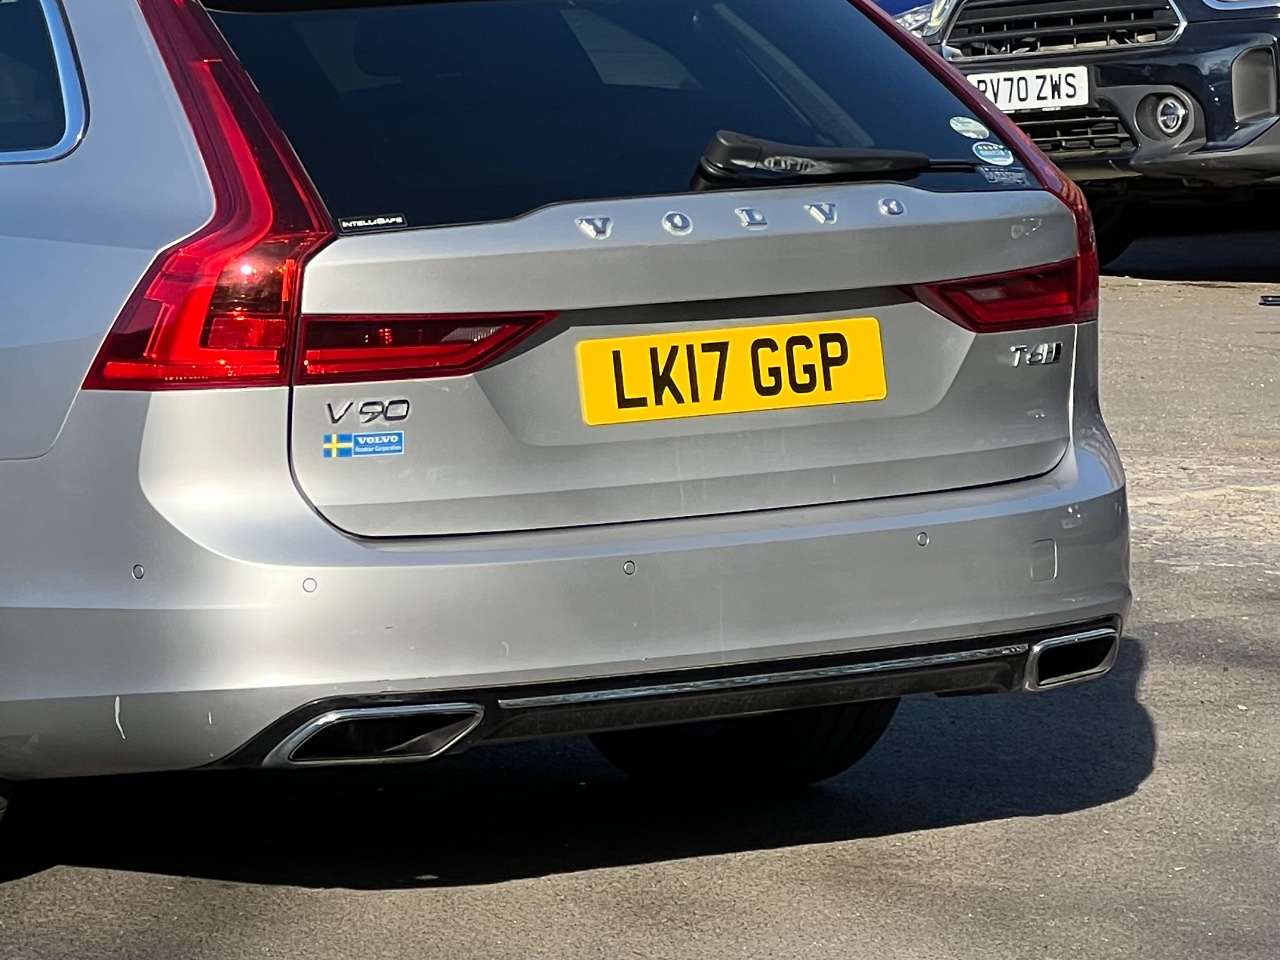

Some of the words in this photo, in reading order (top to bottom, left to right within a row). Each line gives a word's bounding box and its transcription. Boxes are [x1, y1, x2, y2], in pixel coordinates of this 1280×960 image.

[1035, 73, 1077, 101] ZWS
[575, 198, 906, 240] VOLVO
[611, 340, 730, 410] LK17
[749, 332, 849, 398] GGP
[326, 399, 410, 424] V90
[357, 435, 399, 445] VOLVO
